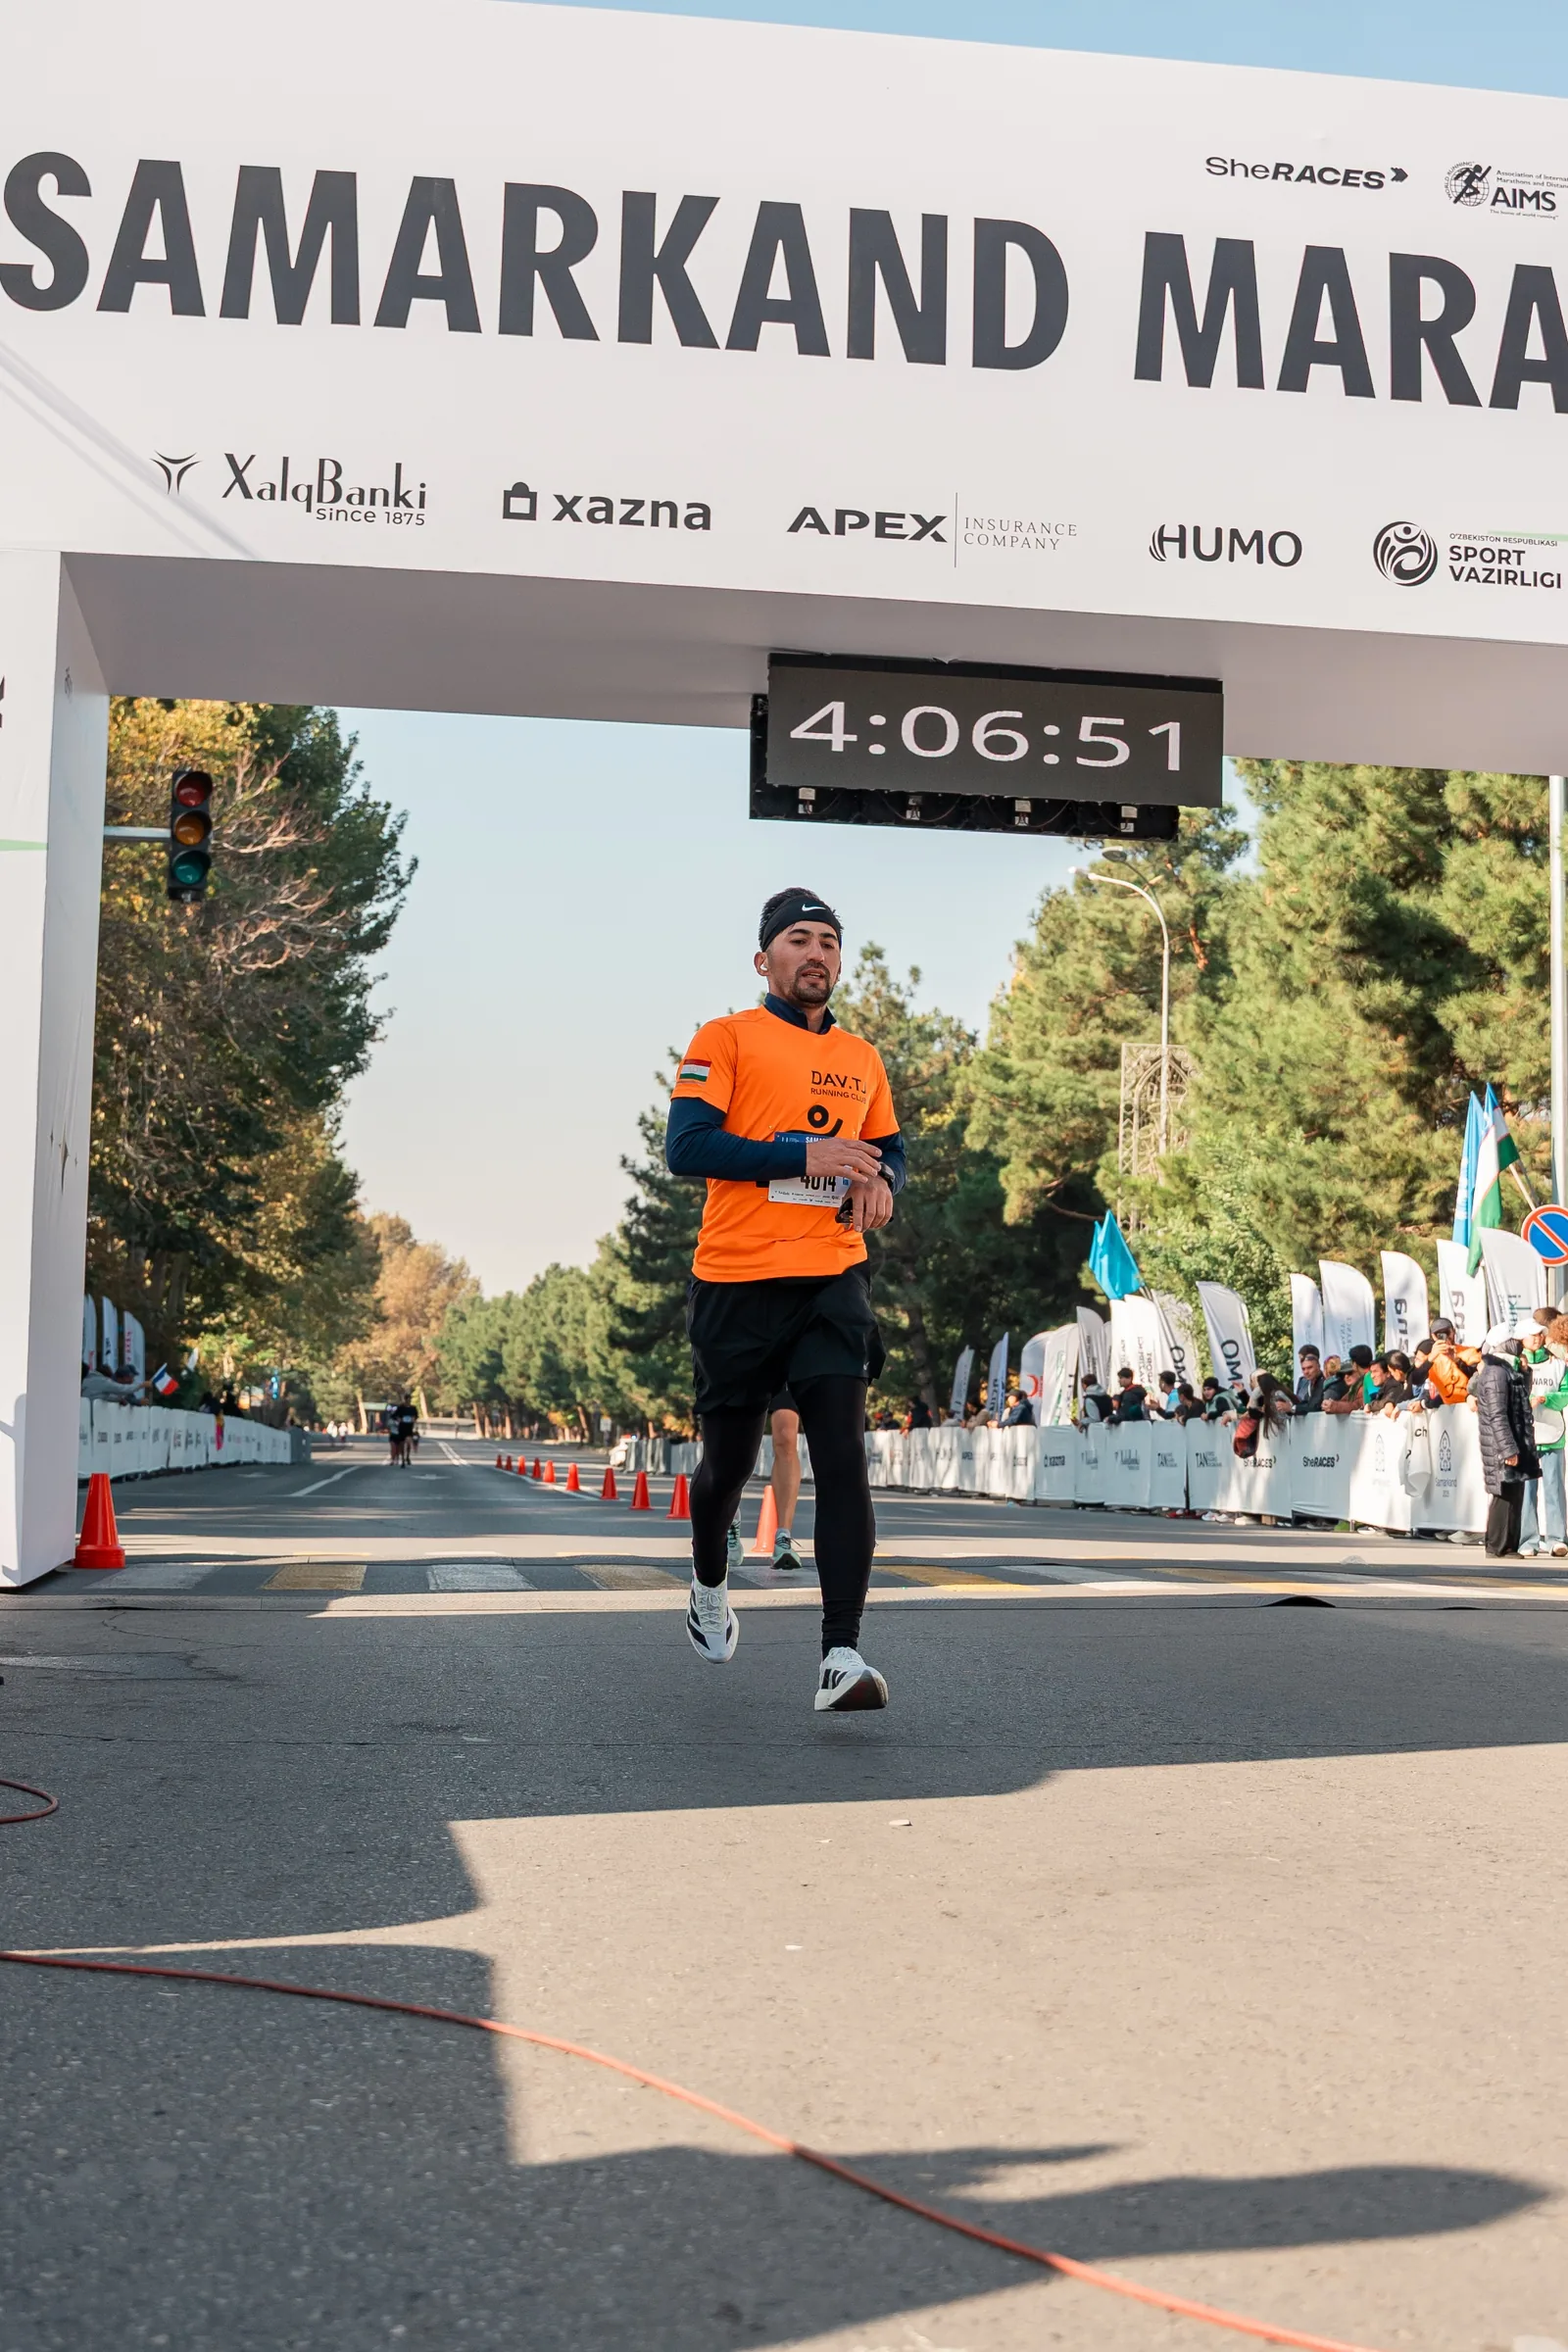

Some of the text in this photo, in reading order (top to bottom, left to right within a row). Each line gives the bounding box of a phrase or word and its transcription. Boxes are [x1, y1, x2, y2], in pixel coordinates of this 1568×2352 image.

[1205, 157, 1386, 189] SheRACES
[1496, 170, 1535, 179] Association
[1496, 177, 1532, 186] Marathons
[1490, 186, 1556, 212] AIMS
[0, 152, 1568, 415] SAMARKAND MARA
[316, 507, 425, 526] since 1875
[552, 494, 711, 530] xazna
[786, 506, 948, 543] APEX
[964, 516, 1077, 537] INSURANCE
[964, 532, 1060, 551] COMPANY
[1149, 523, 1302, 567] HUMO
[1502, 537, 1558, 548] RESPUBLIKASI
[1448, 545, 1526, 566] SPORT
[1448, 564, 1562, 589] VAZIRLIGI
[789, 700, 1181, 772] 4:06:51
[810, 1087, 850, 1099] RUNNING
[1302, 1455, 1336, 1468] SheRACES
